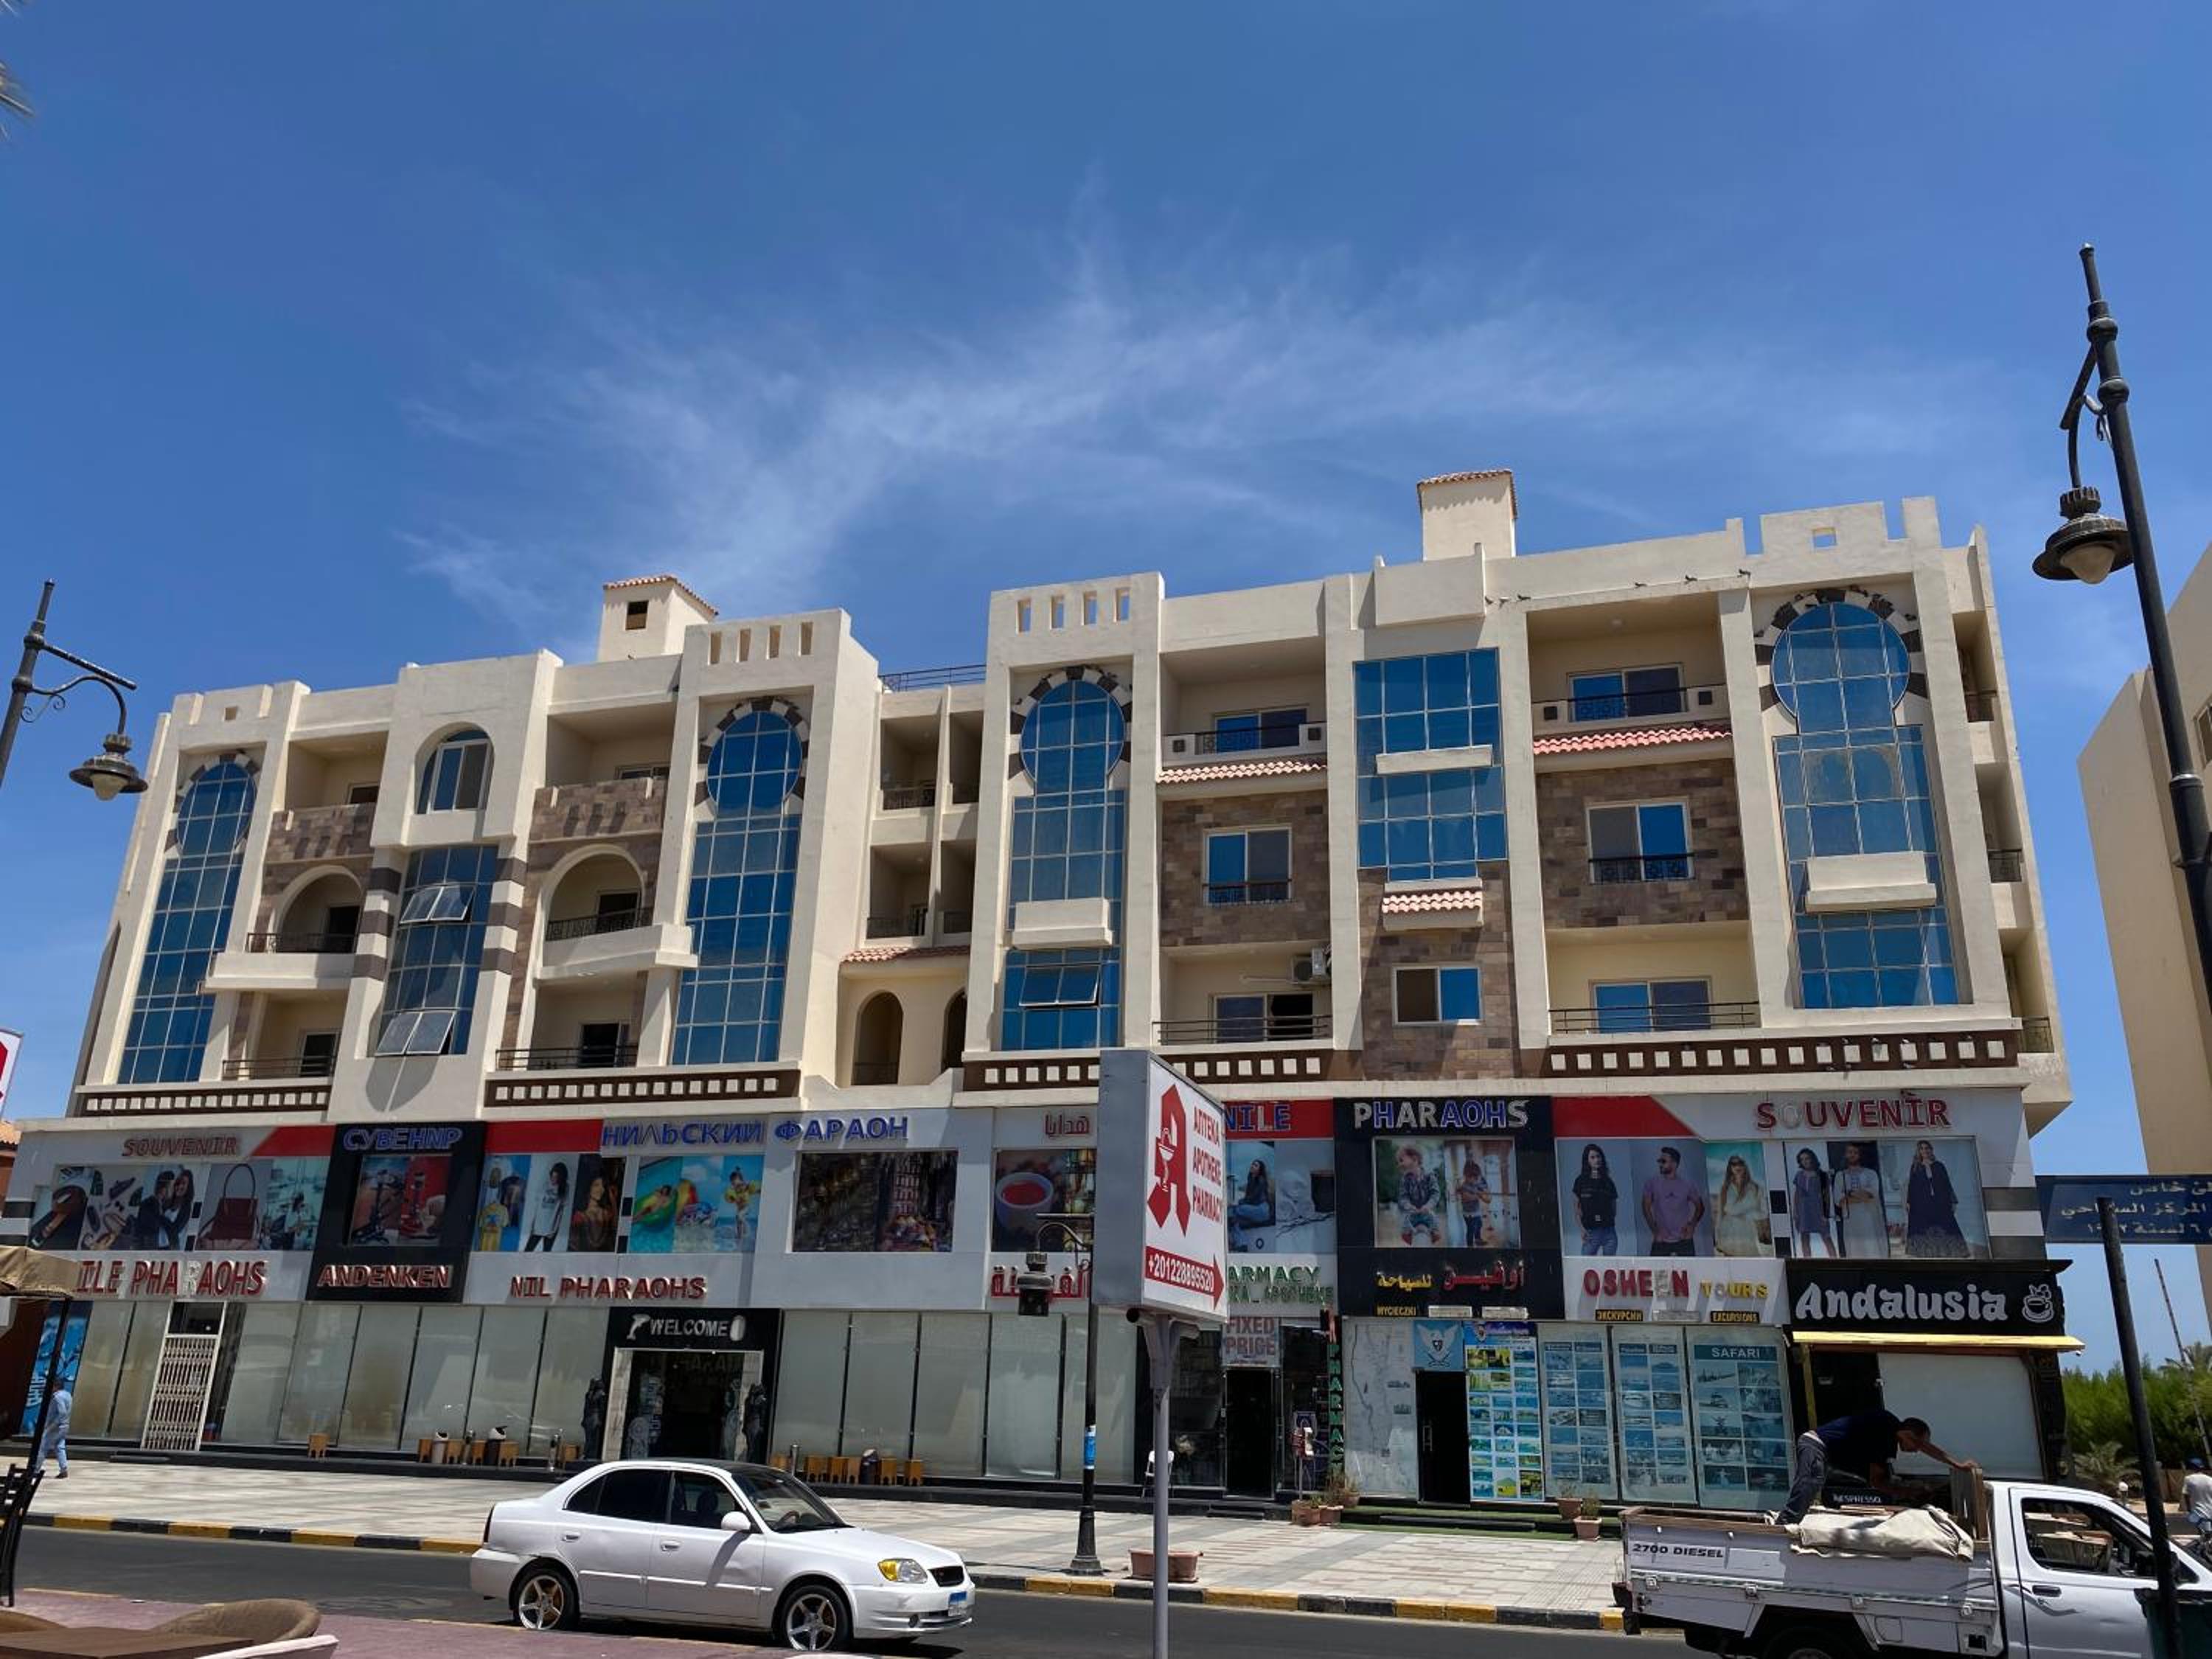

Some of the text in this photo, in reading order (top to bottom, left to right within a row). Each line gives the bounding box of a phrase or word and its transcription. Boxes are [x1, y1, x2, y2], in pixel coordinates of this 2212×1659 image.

[1354, 1099, 1530, 1129] PHARAOHS
[1756, 1098, 1952, 1130] SOUVENIR
[774, 1116, 909, 1141] ФАРАОН
[1044, 1114, 1089, 1138] هدايا
[122, 1136, 237, 1156] SOUVENIR
[1192, 1185, 1223, 1225] PHARMACY
[2062, 1202, 2146, 1220] الساحي
[317, 1265, 454, 1287] ANDENKEN
[1583, 1269, 1768, 1300] OSHEEN TOURS
[509, 1276, 707, 1299] NIL PHARAOHS
[1795, 1282, 2008, 1321] Andalusia
[650, 1318, 728, 1336] WELCOME
[1226, 1318, 1275, 1333] FIXED
[1226, 1337, 1276, 1355] PRICE
[1711, 1347, 1760, 1358] SAFARI
[1632, 1544, 1723, 1557] 2700 DIESEL
